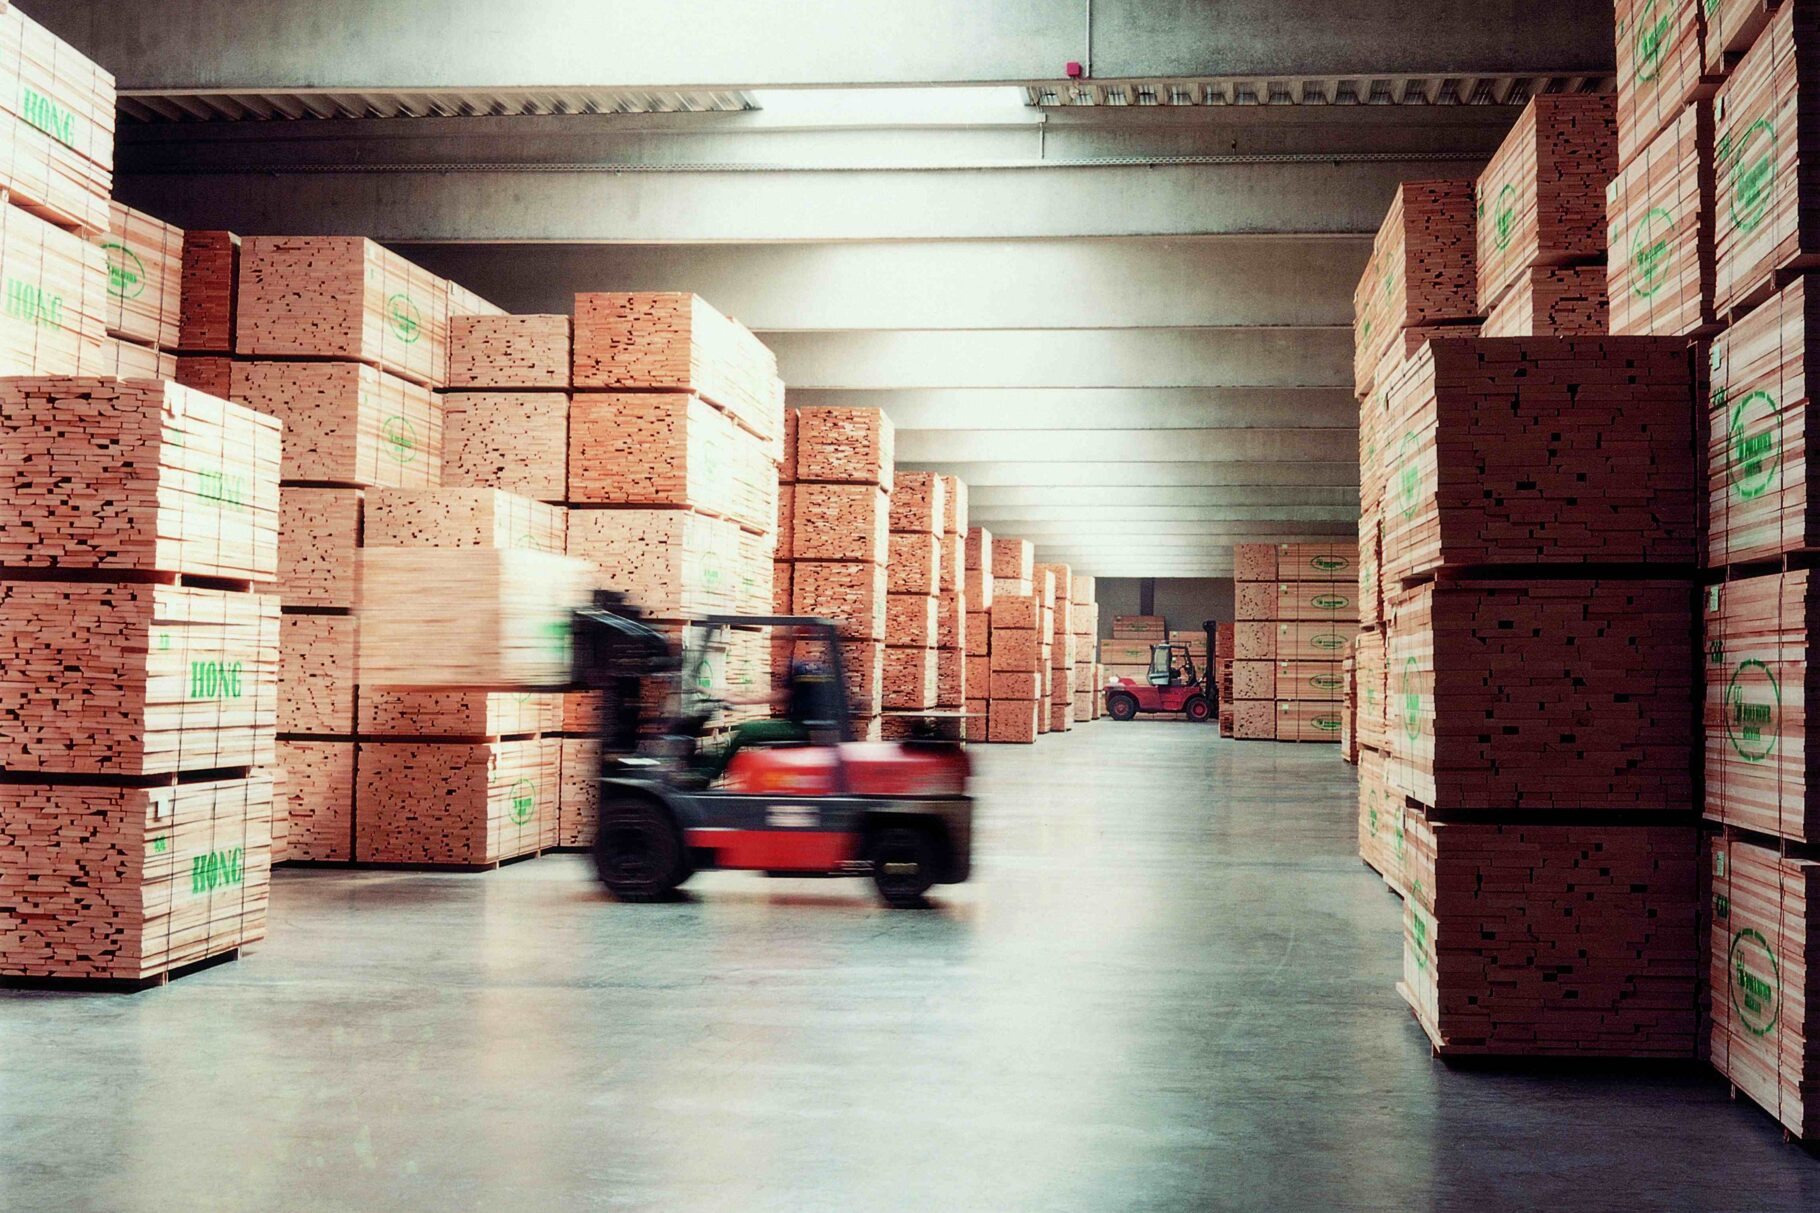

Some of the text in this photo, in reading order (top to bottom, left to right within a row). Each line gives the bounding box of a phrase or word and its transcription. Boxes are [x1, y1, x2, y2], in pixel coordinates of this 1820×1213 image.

[23, 87, 75, 148] HONG
[6, 277, 62, 332] HONG
[190, 661, 242, 699] HONG
[192, 847, 243, 894] HONG
